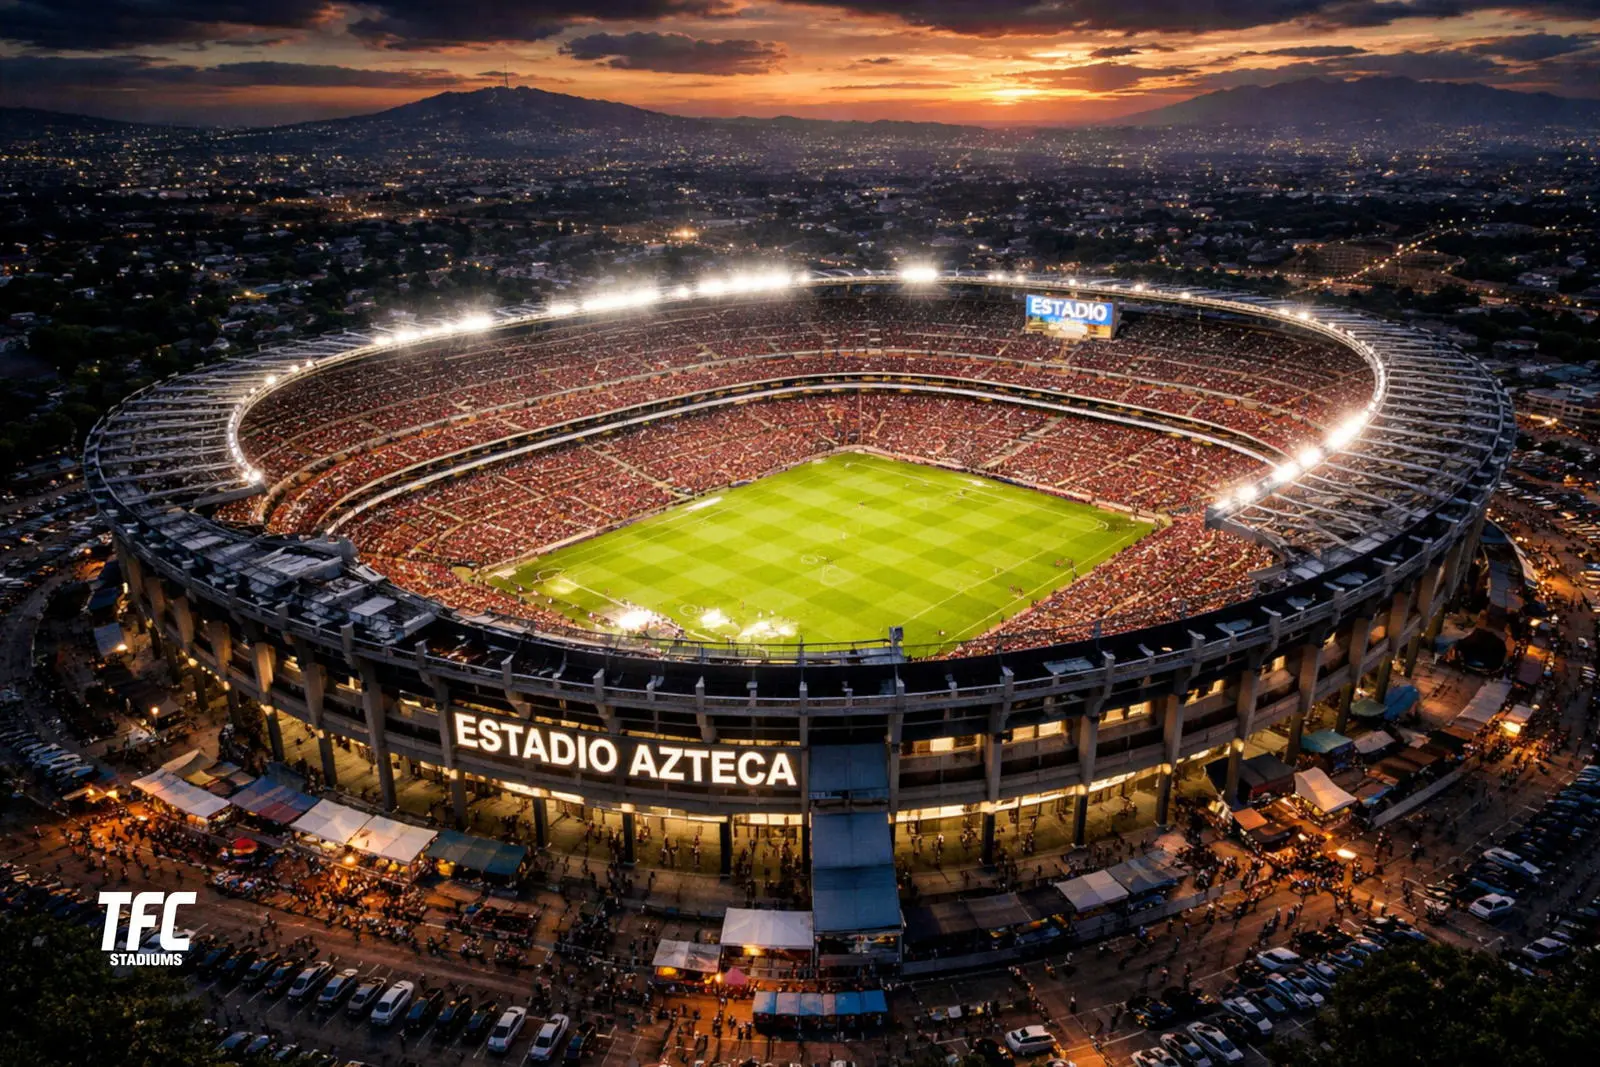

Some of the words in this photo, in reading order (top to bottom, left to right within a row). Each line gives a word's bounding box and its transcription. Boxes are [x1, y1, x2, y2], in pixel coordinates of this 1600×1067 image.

[1031, 298, 1107, 321] ESTADIO
[454, 712, 618, 773] ESTADIO
[629, 744, 797, 786] AZTECA
